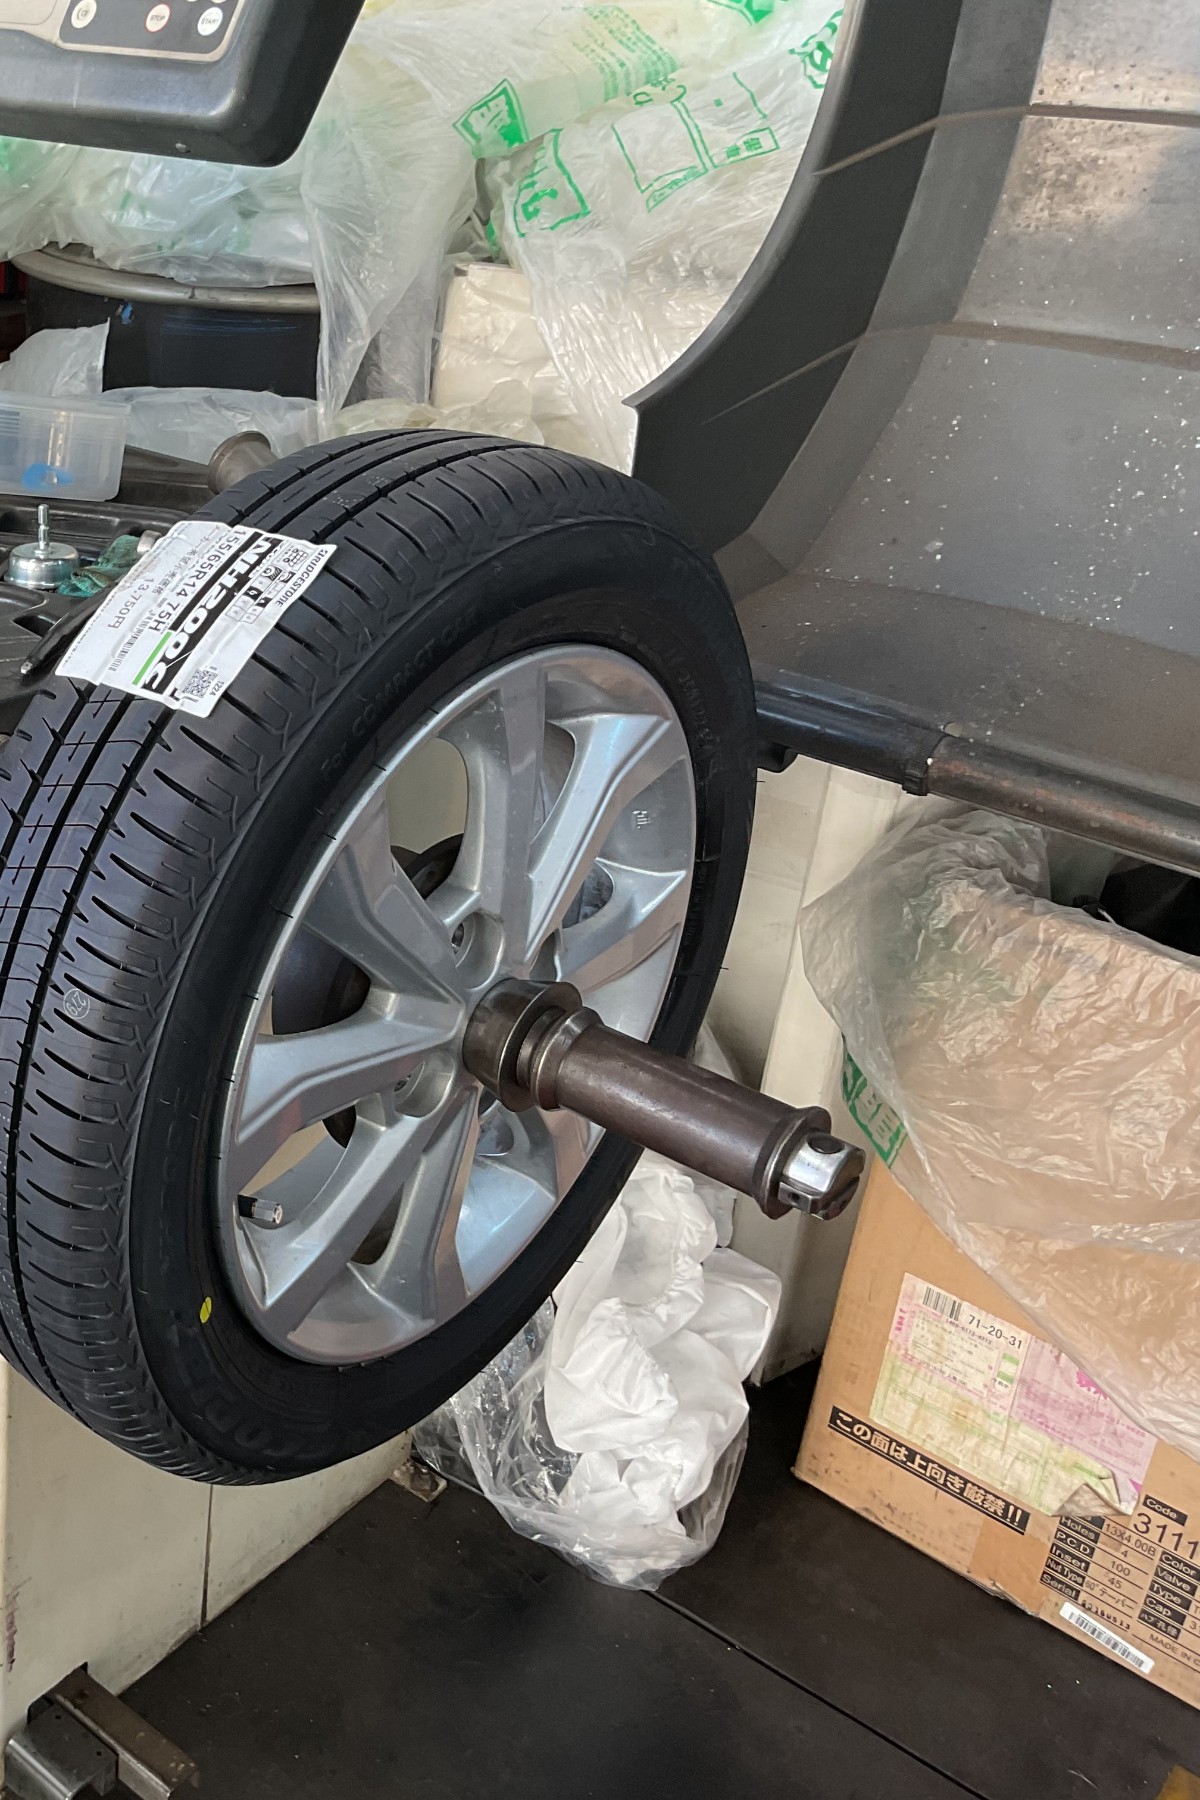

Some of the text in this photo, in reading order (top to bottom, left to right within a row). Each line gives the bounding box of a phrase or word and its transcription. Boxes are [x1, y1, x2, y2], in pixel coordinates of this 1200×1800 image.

[150, 14, 165, 22] STOP
[148, 530, 246, 632] 155/65R14 75H
[275, 549, 328, 607] BRIDGESTONE
[968, 1314, 1023, 1350] 71-20-31
[835, 1412, 1022, 1527] この面は上向き厳禁!!
[1146, 1499, 1178, 1519] Code
[1060, 1516, 1096, 1540] Holes
[1121, 1550, 1128, 1558] 4
[1105, 1523, 1156, 1557] 13X4.00B
[1051, 1545, 1087, 1571] Inset
[1111, 1560, 1131, 1577] 100
[1162, 1553, 1198, 1577] Color
[1046, 1559, 1062, 1574] Nut
[1063, 1567, 1083, 1584] Type
[1156, 1567, 1191, 1591] Valve
[1041, 1574, 1077, 1598] Serial
[1152, 1582, 1182, 1605] Type
[1146, 1599, 1172, 1617] Cap
[1150, 1633, 1179, 1653] MADE
[1180, 1652, 1191, 1662] IN
